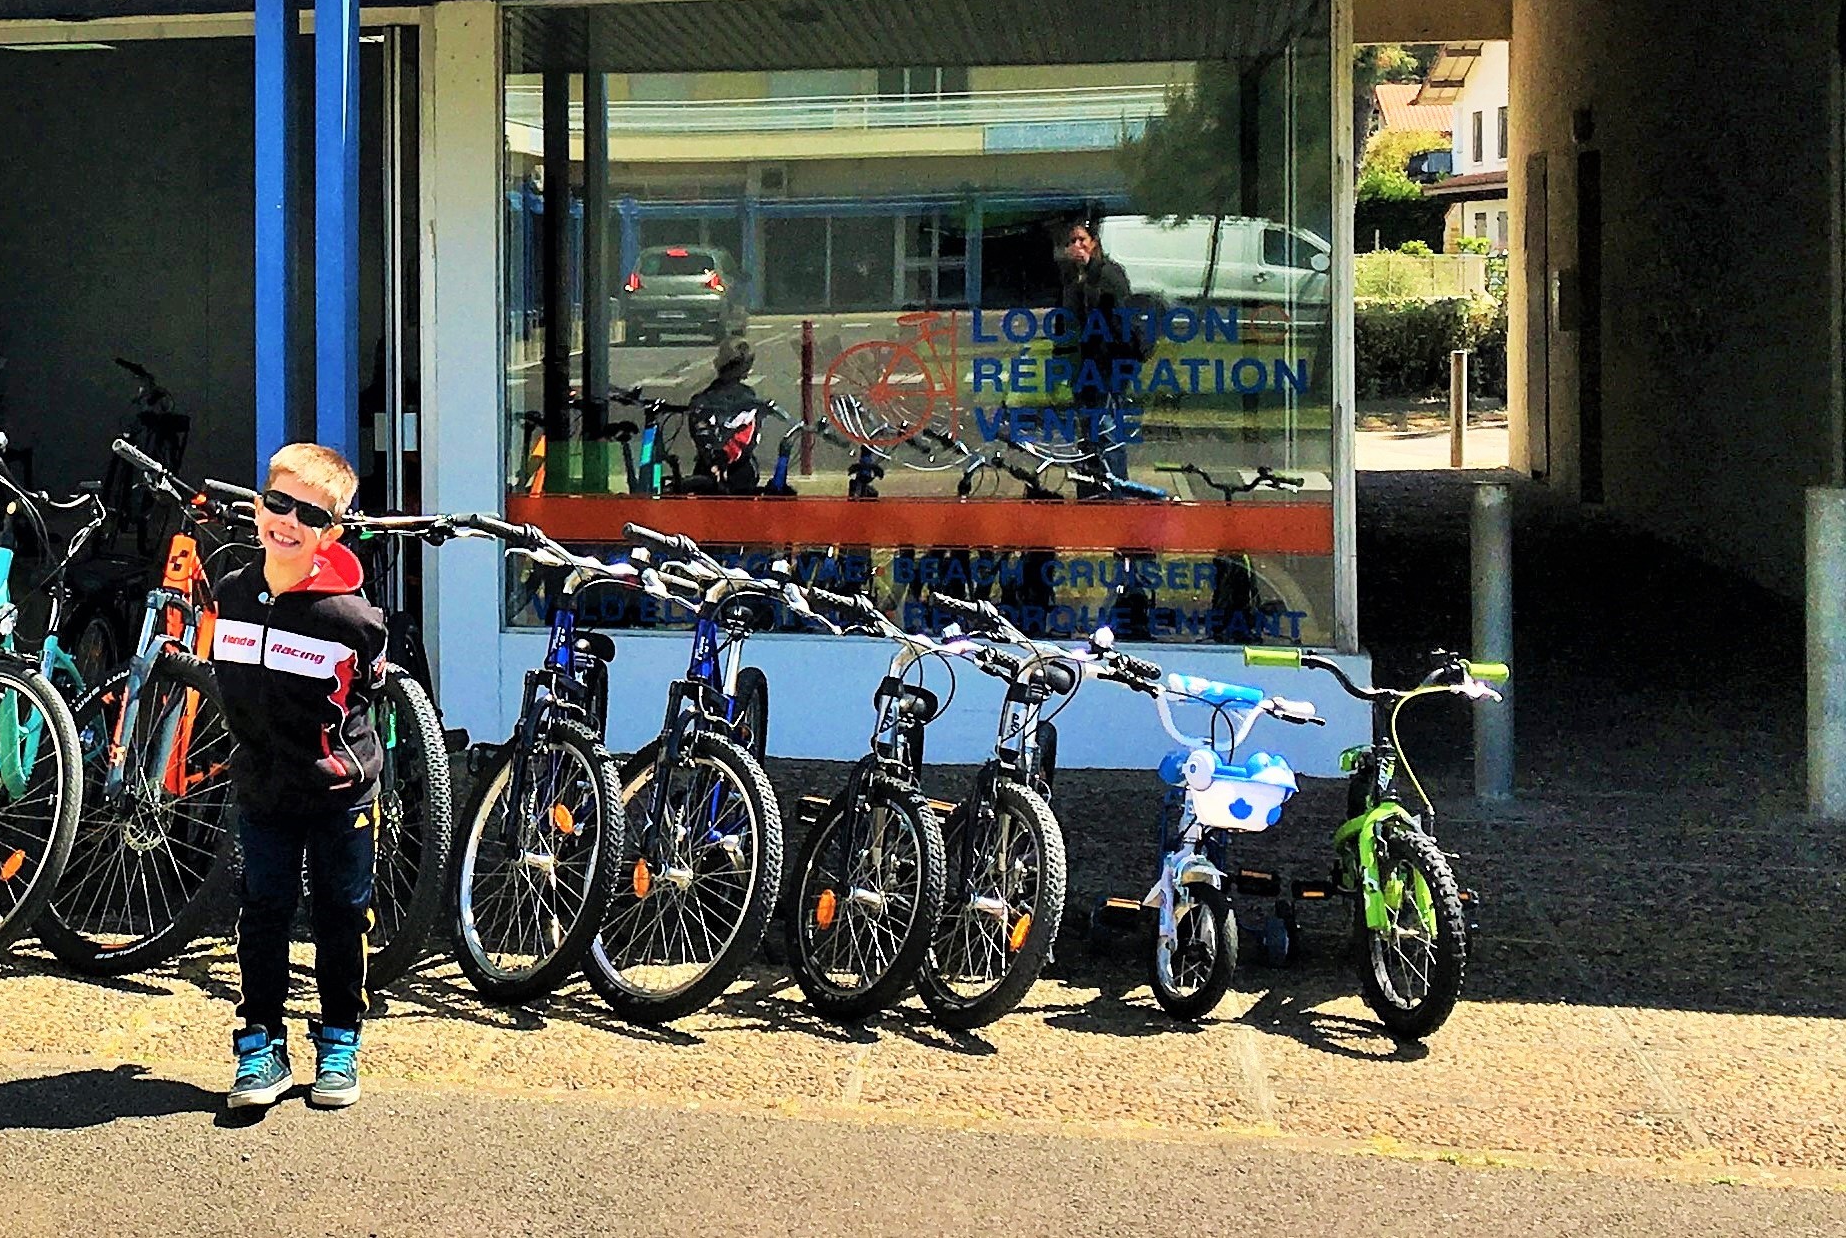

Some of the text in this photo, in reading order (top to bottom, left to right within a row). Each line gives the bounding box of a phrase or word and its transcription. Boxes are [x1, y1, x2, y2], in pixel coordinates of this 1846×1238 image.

[972, 307, 1239, 344] LOCATION
[972, 347, 1310, 394] RÉPARATION
[973, 407, 1144, 444] VENTE
[893, 557, 1024, 588] BEACH
[1041, 559, 1217, 590] CRUISER
[1149, 607, 1307, 639] ENFANT
[270, 643, 326, 664] Racing
